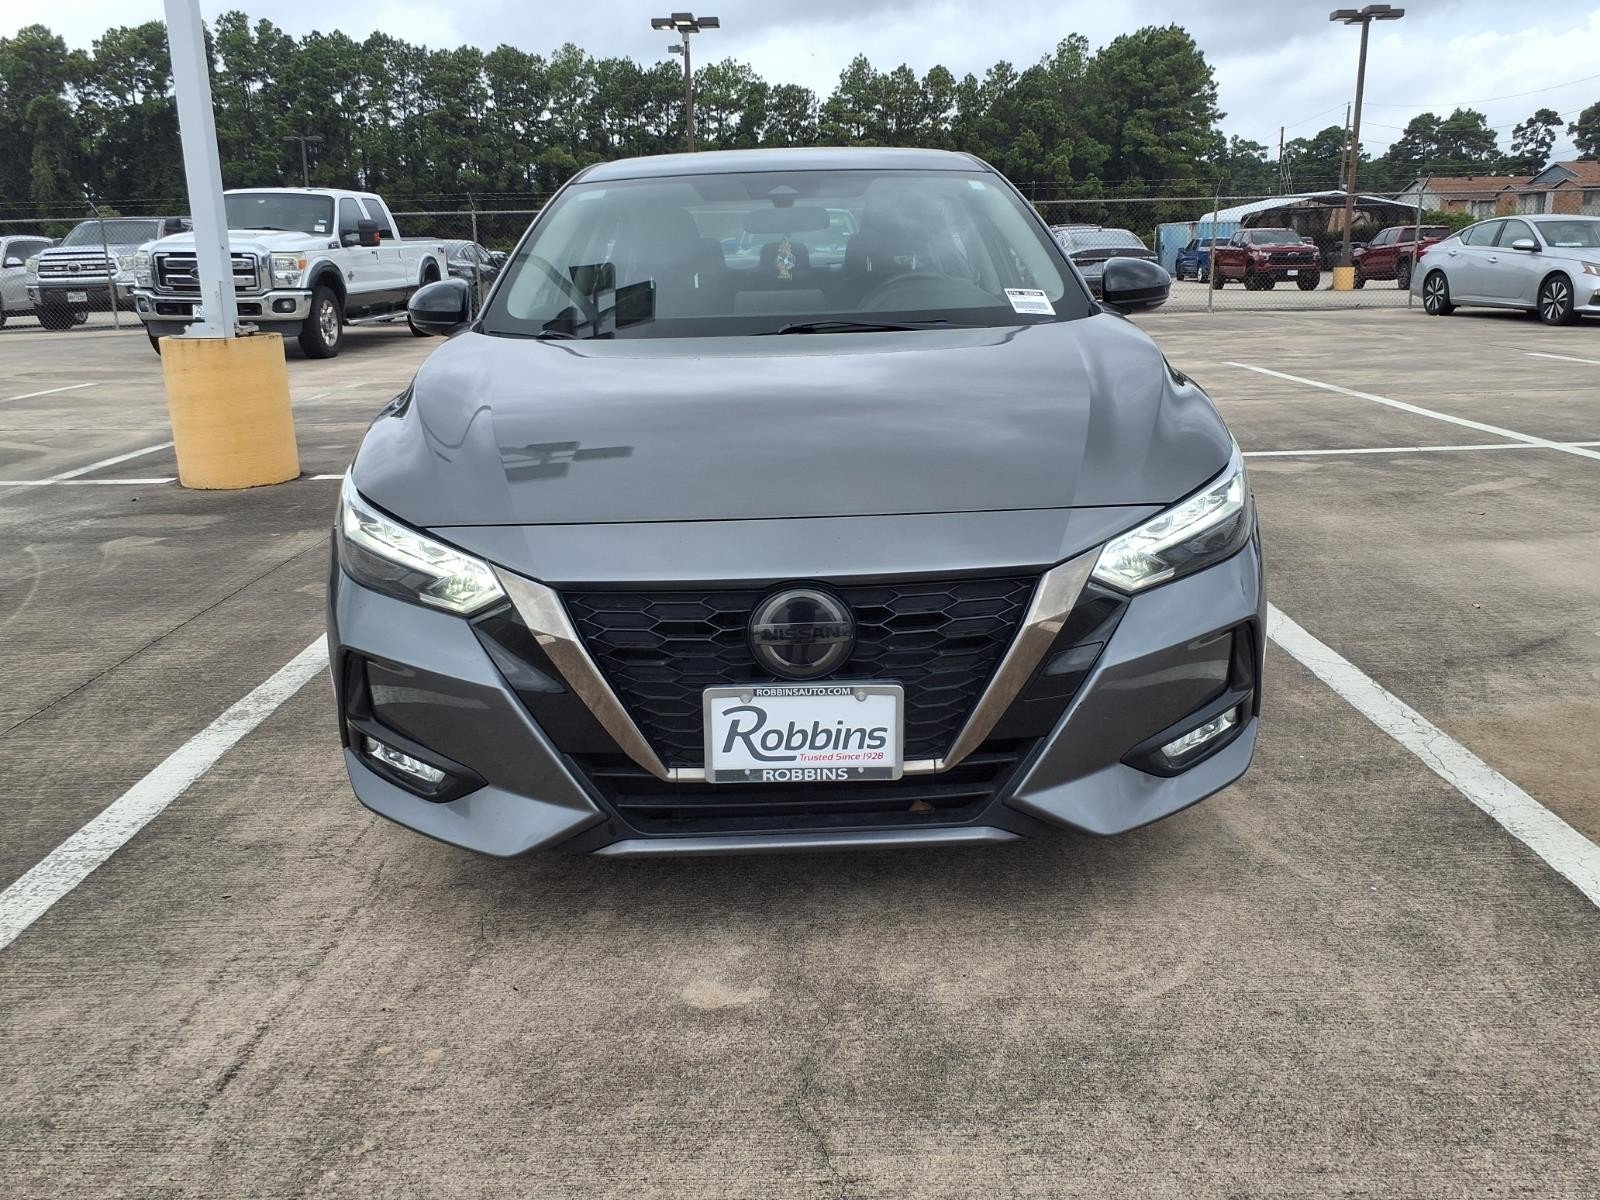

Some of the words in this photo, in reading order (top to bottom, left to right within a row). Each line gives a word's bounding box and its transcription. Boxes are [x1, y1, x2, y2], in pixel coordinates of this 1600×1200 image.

[761, 624, 849, 641] NISSAN
[756, 687, 851, 697] ROBBINSAUTO.COM
[721, 705, 888, 762] Robbins
[799, 753, 834, 761] Trusted
[835, 752, 861, 761] Since
[862, 751, 884, 760] 1928
[762, 767, 849, 781] ROBBINS
